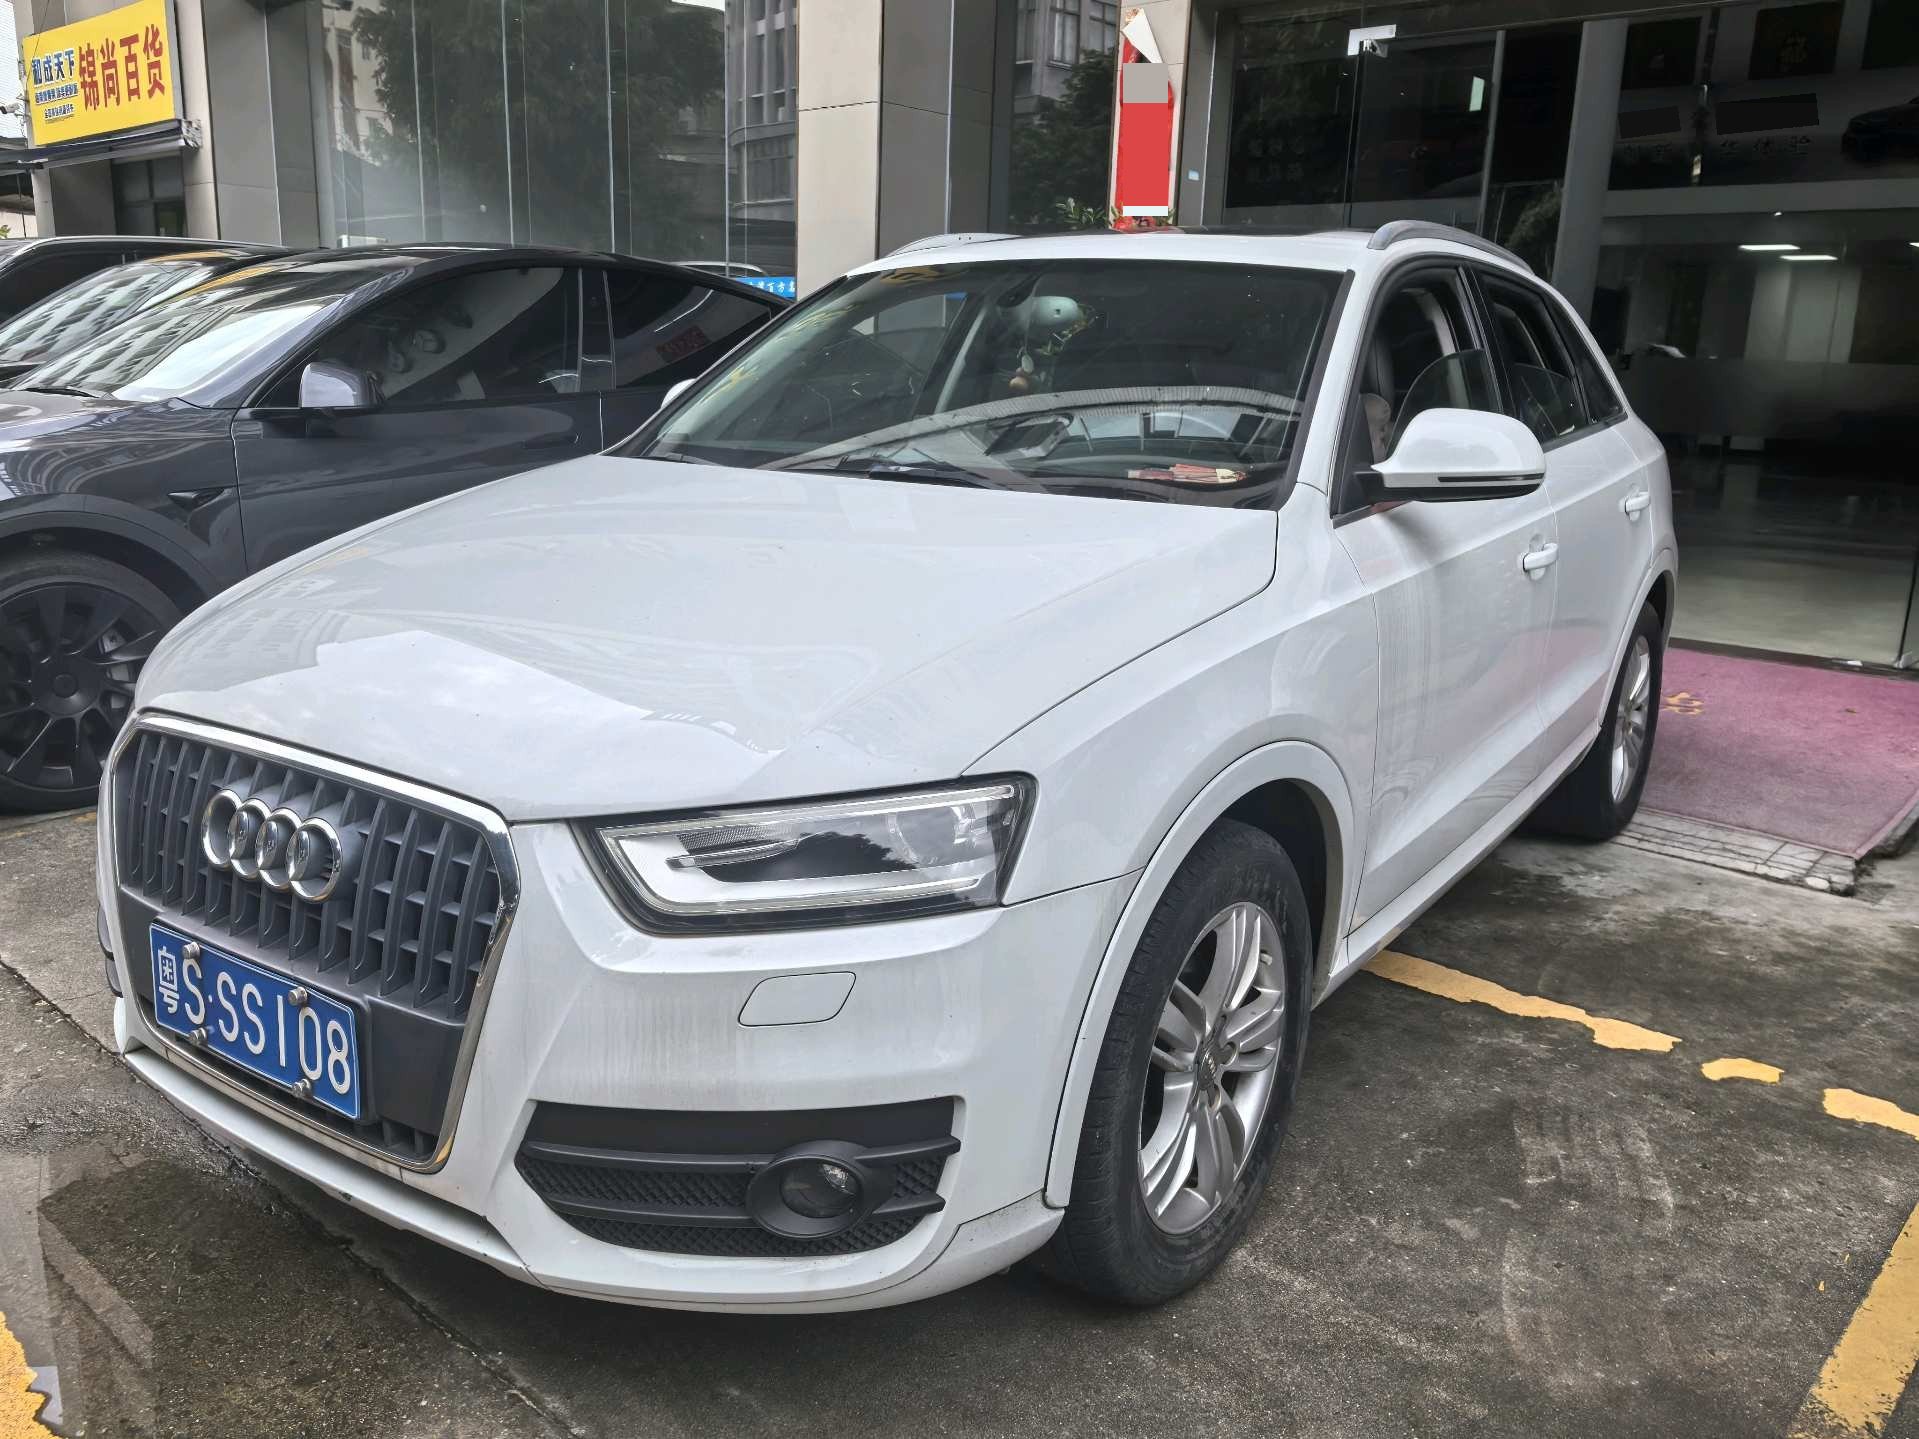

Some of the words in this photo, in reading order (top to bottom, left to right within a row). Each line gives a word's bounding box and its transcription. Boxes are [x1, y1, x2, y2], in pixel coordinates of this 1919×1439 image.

[31, 49, 75, 86] 和成天下
[78, 23, 166, 111] 锦尚百货
